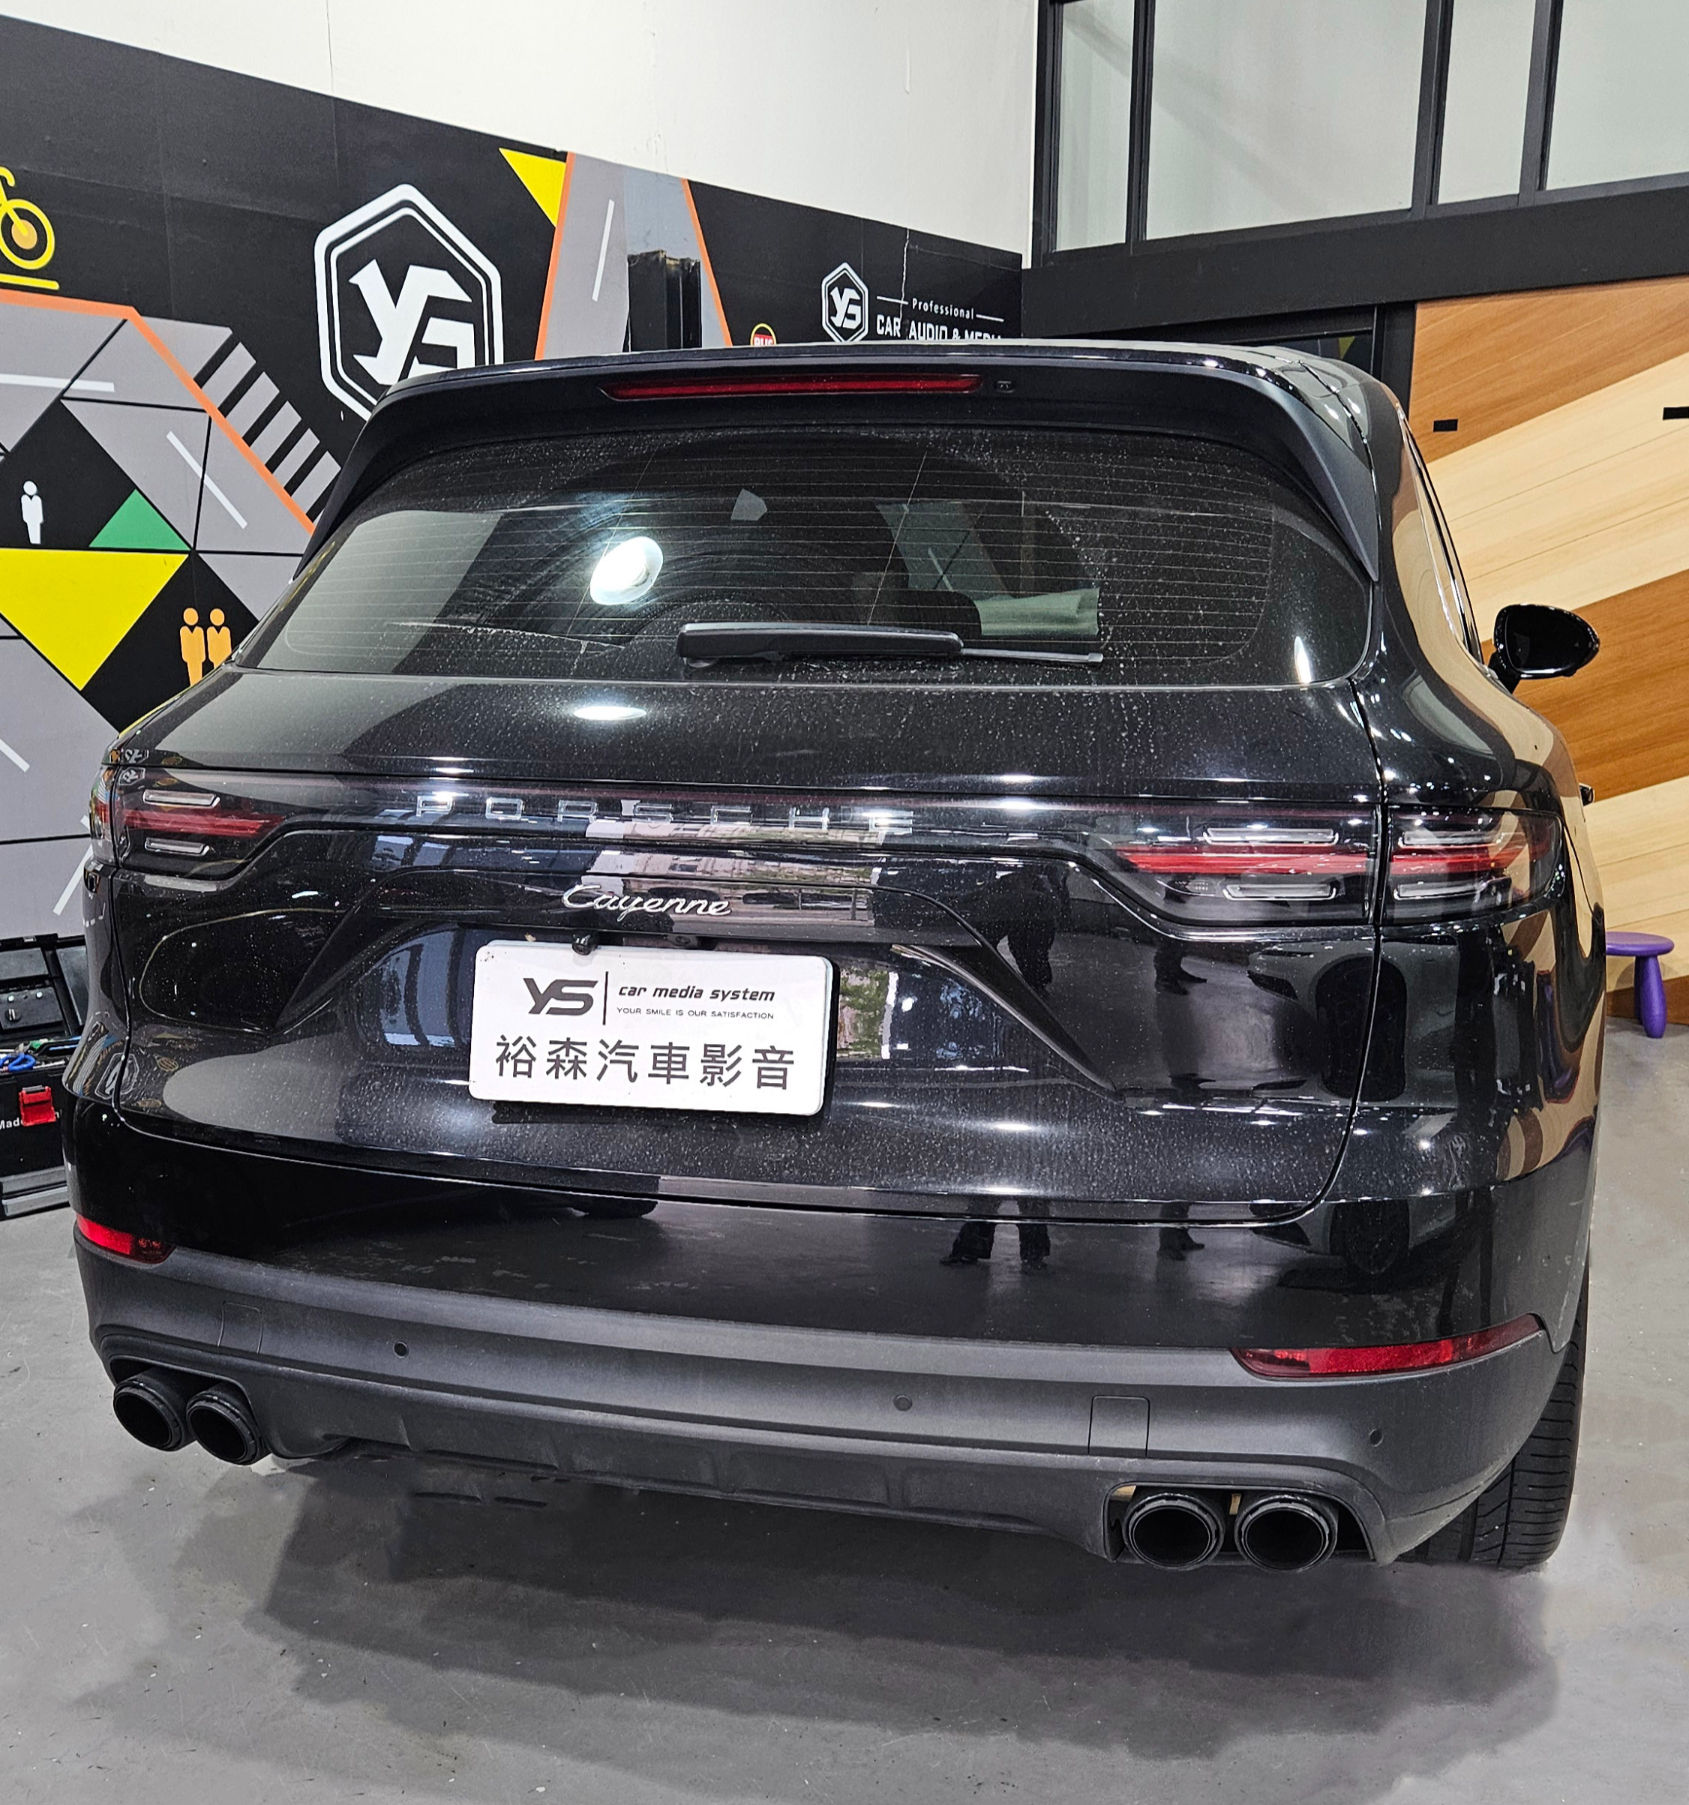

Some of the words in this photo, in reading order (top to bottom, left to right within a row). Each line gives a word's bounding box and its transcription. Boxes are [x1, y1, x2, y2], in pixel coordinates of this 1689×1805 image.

[912, 298, 974, 320] Professional
[876, 314, 901, 338] CAR
[908, 320, 948, 340] AUDIO
[416, 795, 913, 835] PORSCHE
[562, 884, 732, 921] Cayenne
[523, 977, 599, 1017] YS
[618, 985, 647, 997] car
[653, 985, 704, 999] media
[710, 988, 775, 1002] system
[617, 1007, 642, 1015] YOUR
[646, 1008, 671, 1016] SMILE
[676, 1009, 684, 1017] IS
[711, 1011, 774, 1020] SATISFACTION
[496, 1034, 795, 1091] 裕森汽車影音
